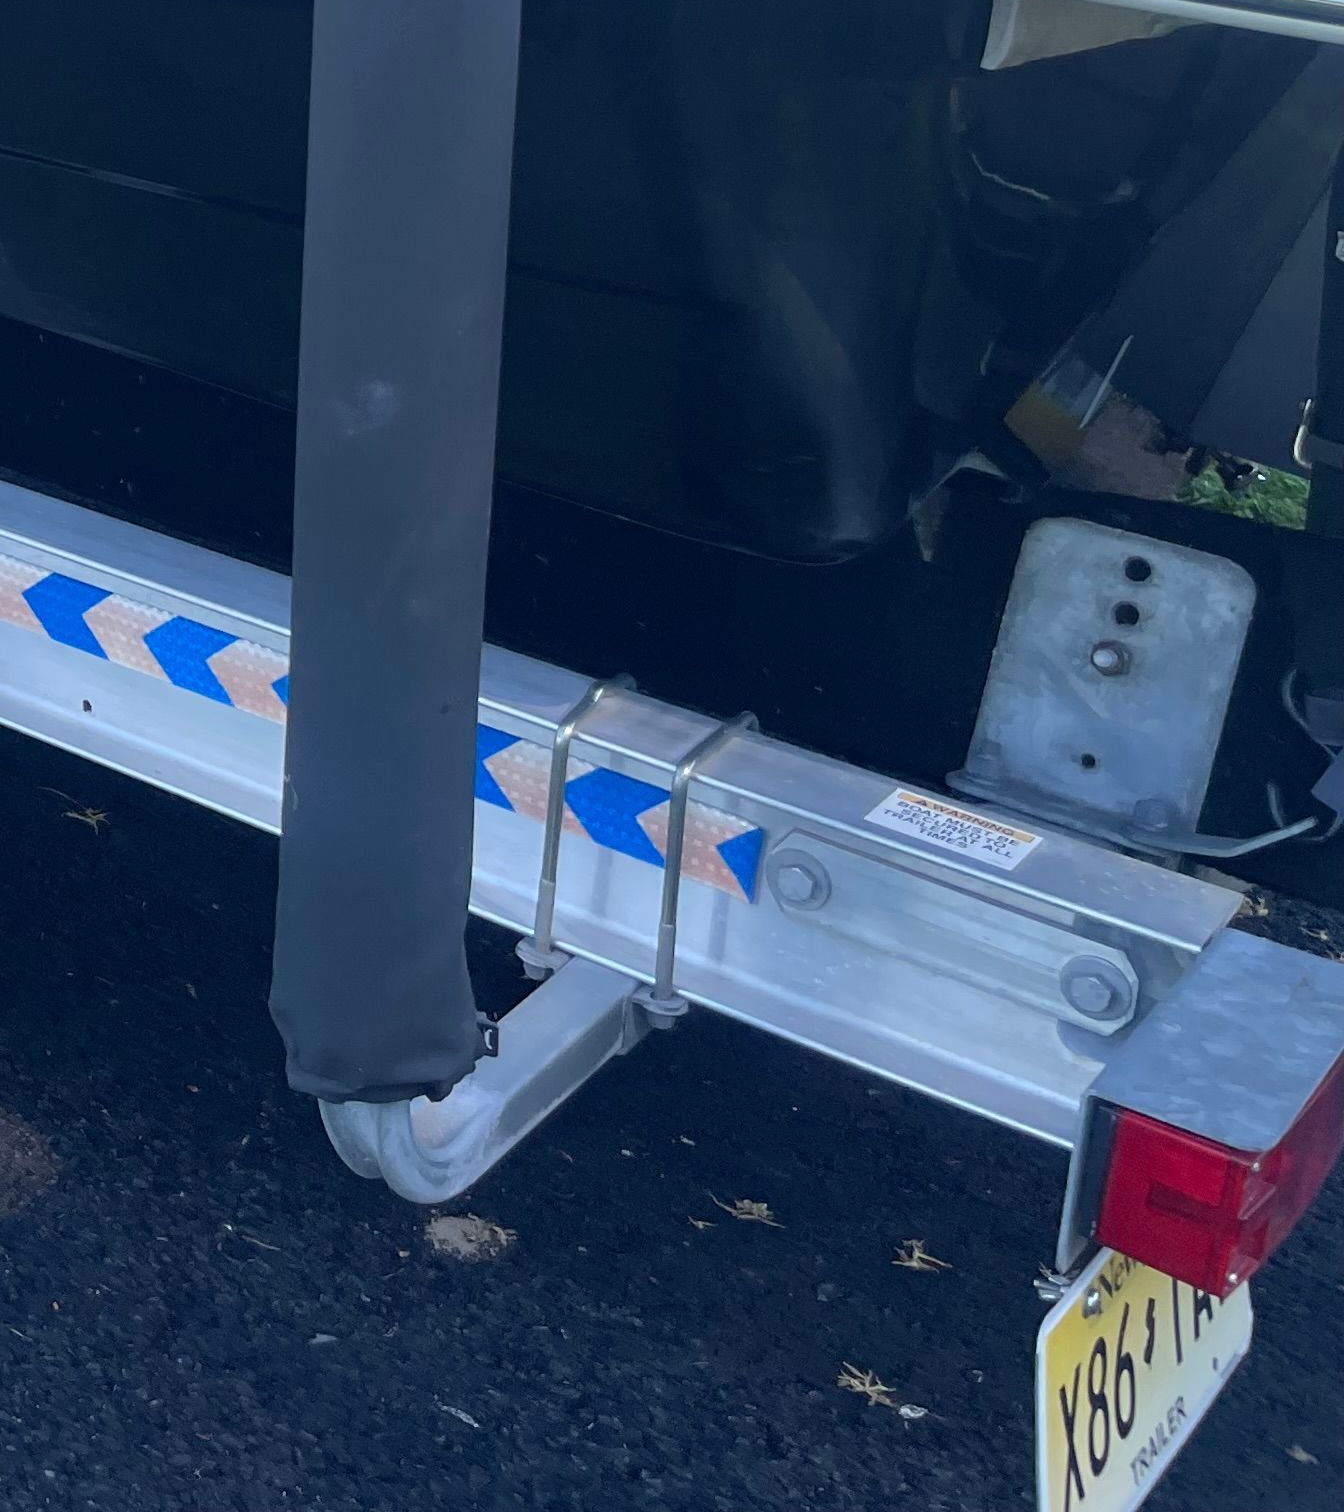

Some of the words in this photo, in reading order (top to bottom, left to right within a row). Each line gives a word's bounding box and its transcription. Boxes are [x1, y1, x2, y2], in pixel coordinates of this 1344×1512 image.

[883, 808, 955, 838] TRAILER
[957, 835, 981, 846] AT
[980, 844, 1013, 858] ALL
[897, 801, 939, 819] BOAT
[945, 817, 996, 838] MUST
[997, 834, 1021, 847] BE
[900, 809, 981, 840] SECURED
[985, 837, 1007, 849] TO
[919, 828, 970, 850] TIMES
[930, 802, 1015, 837] WARNING
[1129, 1395, 1189, 1487] TRAILER
